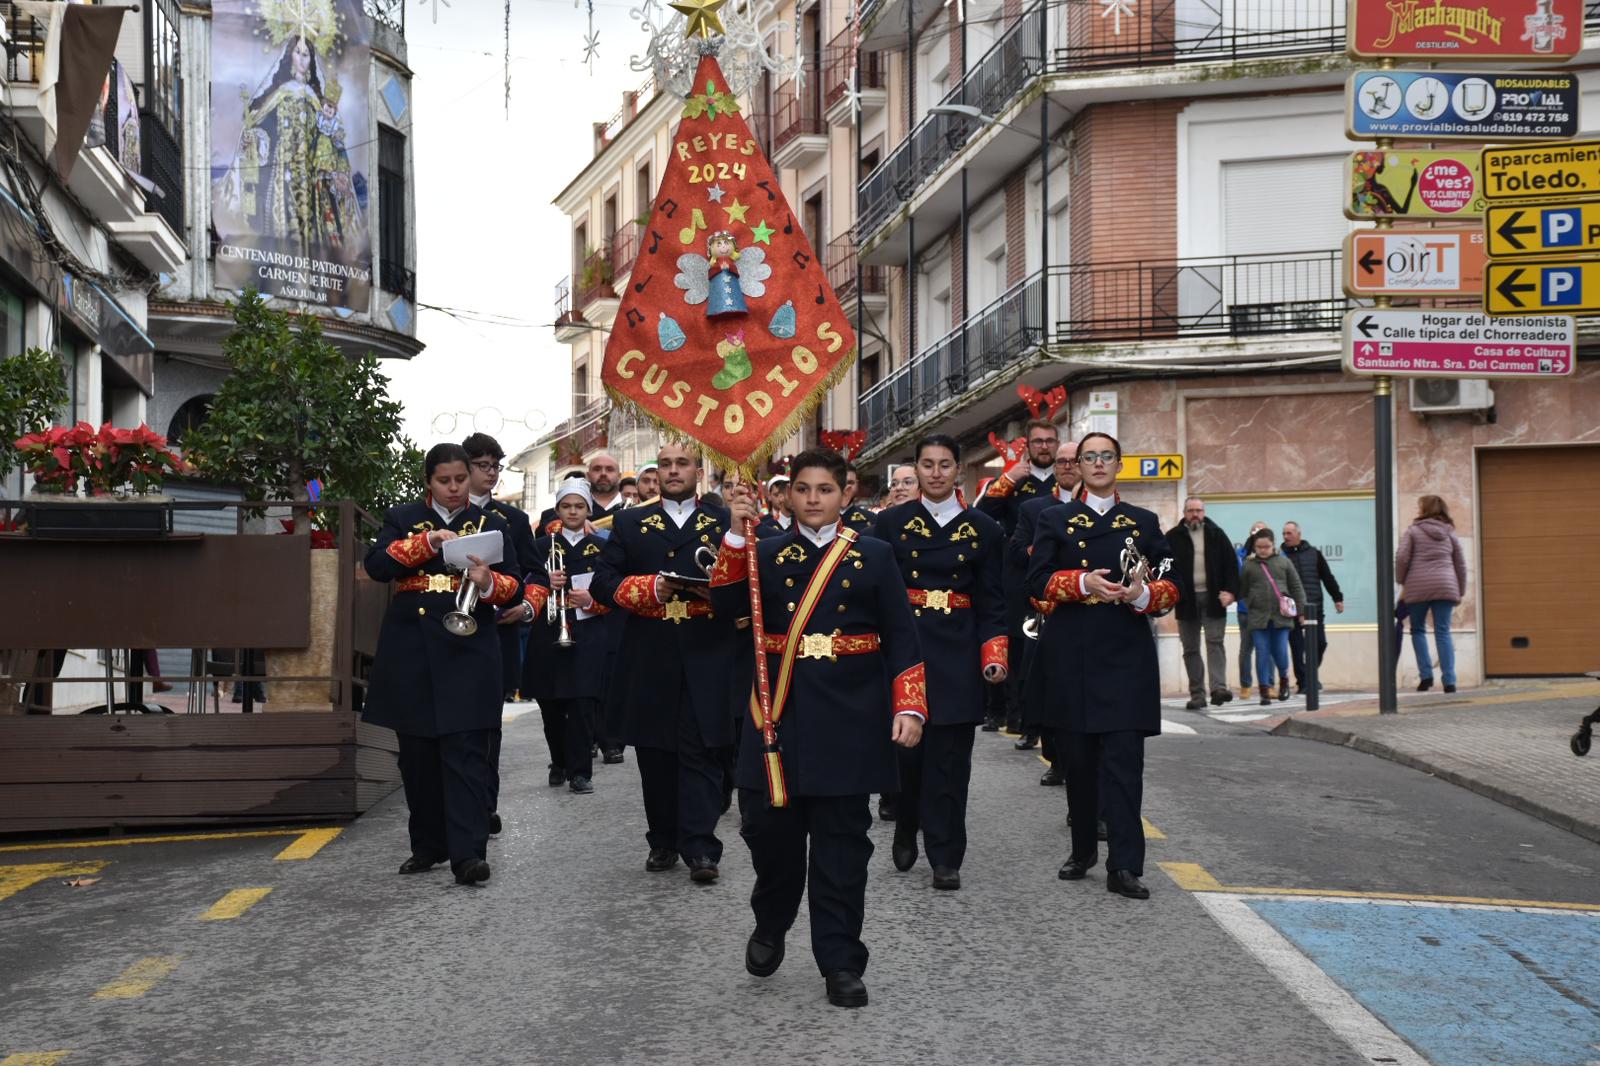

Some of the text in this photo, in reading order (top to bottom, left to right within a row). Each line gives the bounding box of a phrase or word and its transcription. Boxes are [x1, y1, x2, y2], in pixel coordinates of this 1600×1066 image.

[1495, 79, 1570, 89] BIOSALUDABLES
[1502, 112, 1569, 122] 619 472 758
[1369, 122, 1562, 134] www.provialbiosaludables.com
[677, 132, 757, 162] REYES
[687, 162, 747, 185] 2024
[1425, 165, 1458, 180] ¿me
[1435, 176, 1472, 189] ves?
[1491, 169, 1587, 192] Toledo,
[1548, 212, 1575, 244] P
[220, 244, 293, 267] CENTENARIO
[295, 257, 310, 269] DE
[259, 266, 307, 284] CARMEN
[320, 276, 343, 291] RUTE
[280, 286, 298, 297] AÑO
[1549, 271, 1574, 302] P
[1422, 314, 1567, 328] Hogar del Pensionista
[1383, 326, 1567, 341] Calle típica del Chorreadero
[1474, 346, 1567, 358] Casa de Cultura
[1357, 358, 1535, 371] Santuario Ntra. Sra. Del Carmen
[616, 321, 843, 434] CUSTODIOS
[1142, 460, 1156, 476] P
